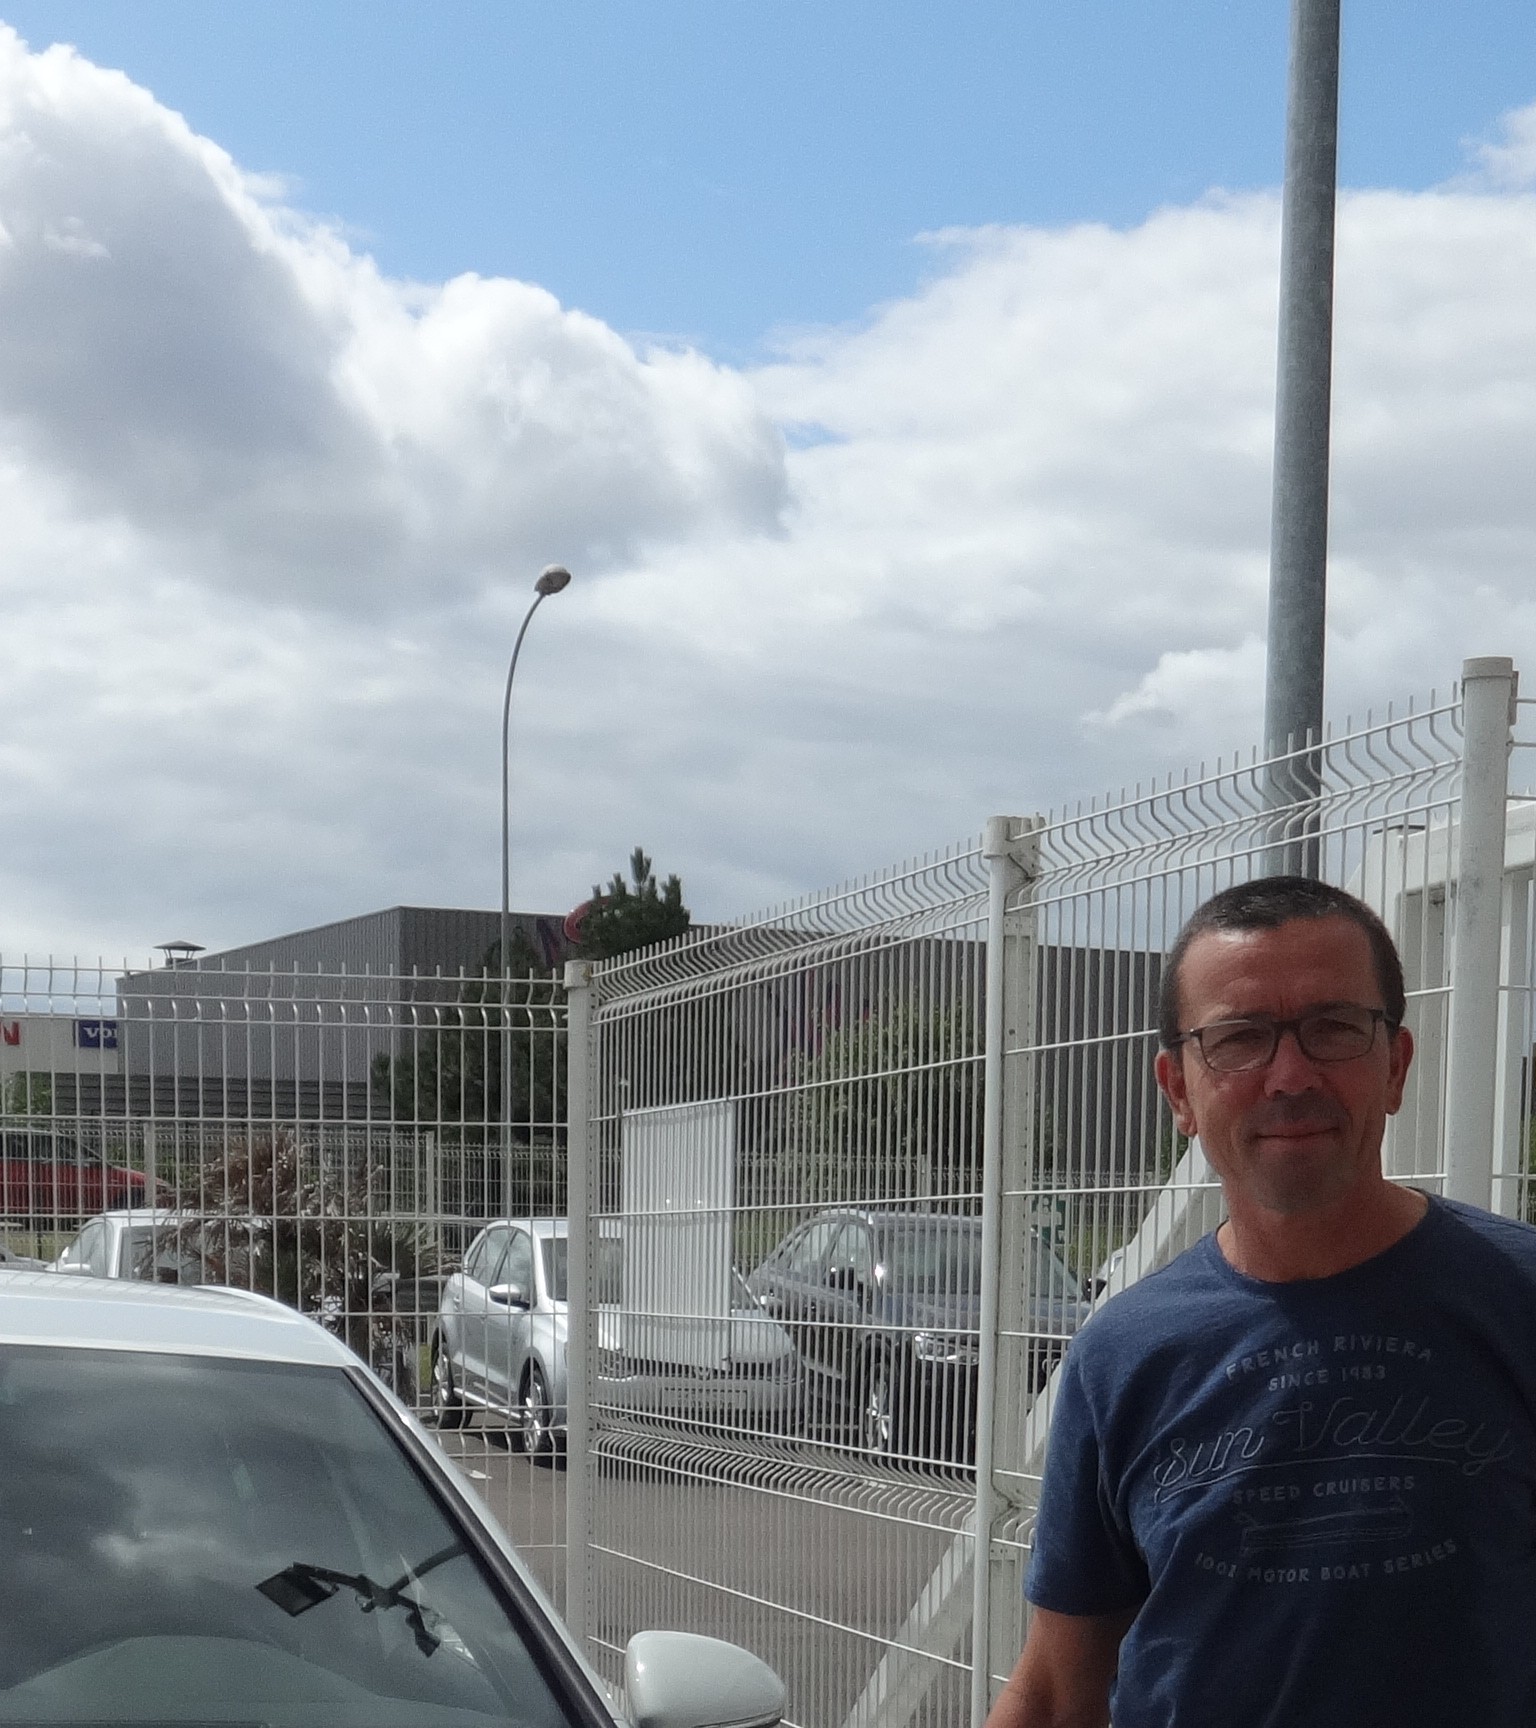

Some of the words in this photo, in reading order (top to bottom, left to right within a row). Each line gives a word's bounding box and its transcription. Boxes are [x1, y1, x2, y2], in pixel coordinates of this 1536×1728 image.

[1225, 1338, 1320, 1381] FRENCH
[1333, 1334, 1432, 1361] RIVIERA
[1268, 1368, 1329, 1392] SINCE
[1153, 1426, 1264, 1488] Sun
[1271, 1395, 1514, 1477] Valley
[1312, 1475, 1416, 1498] CRUISERS
[1248, 1567, 1311, 1584] MOTOR
[1320, 1562, 1371, 1582] BOAT
[1382, 1538, 1457, 1575] SERIES
